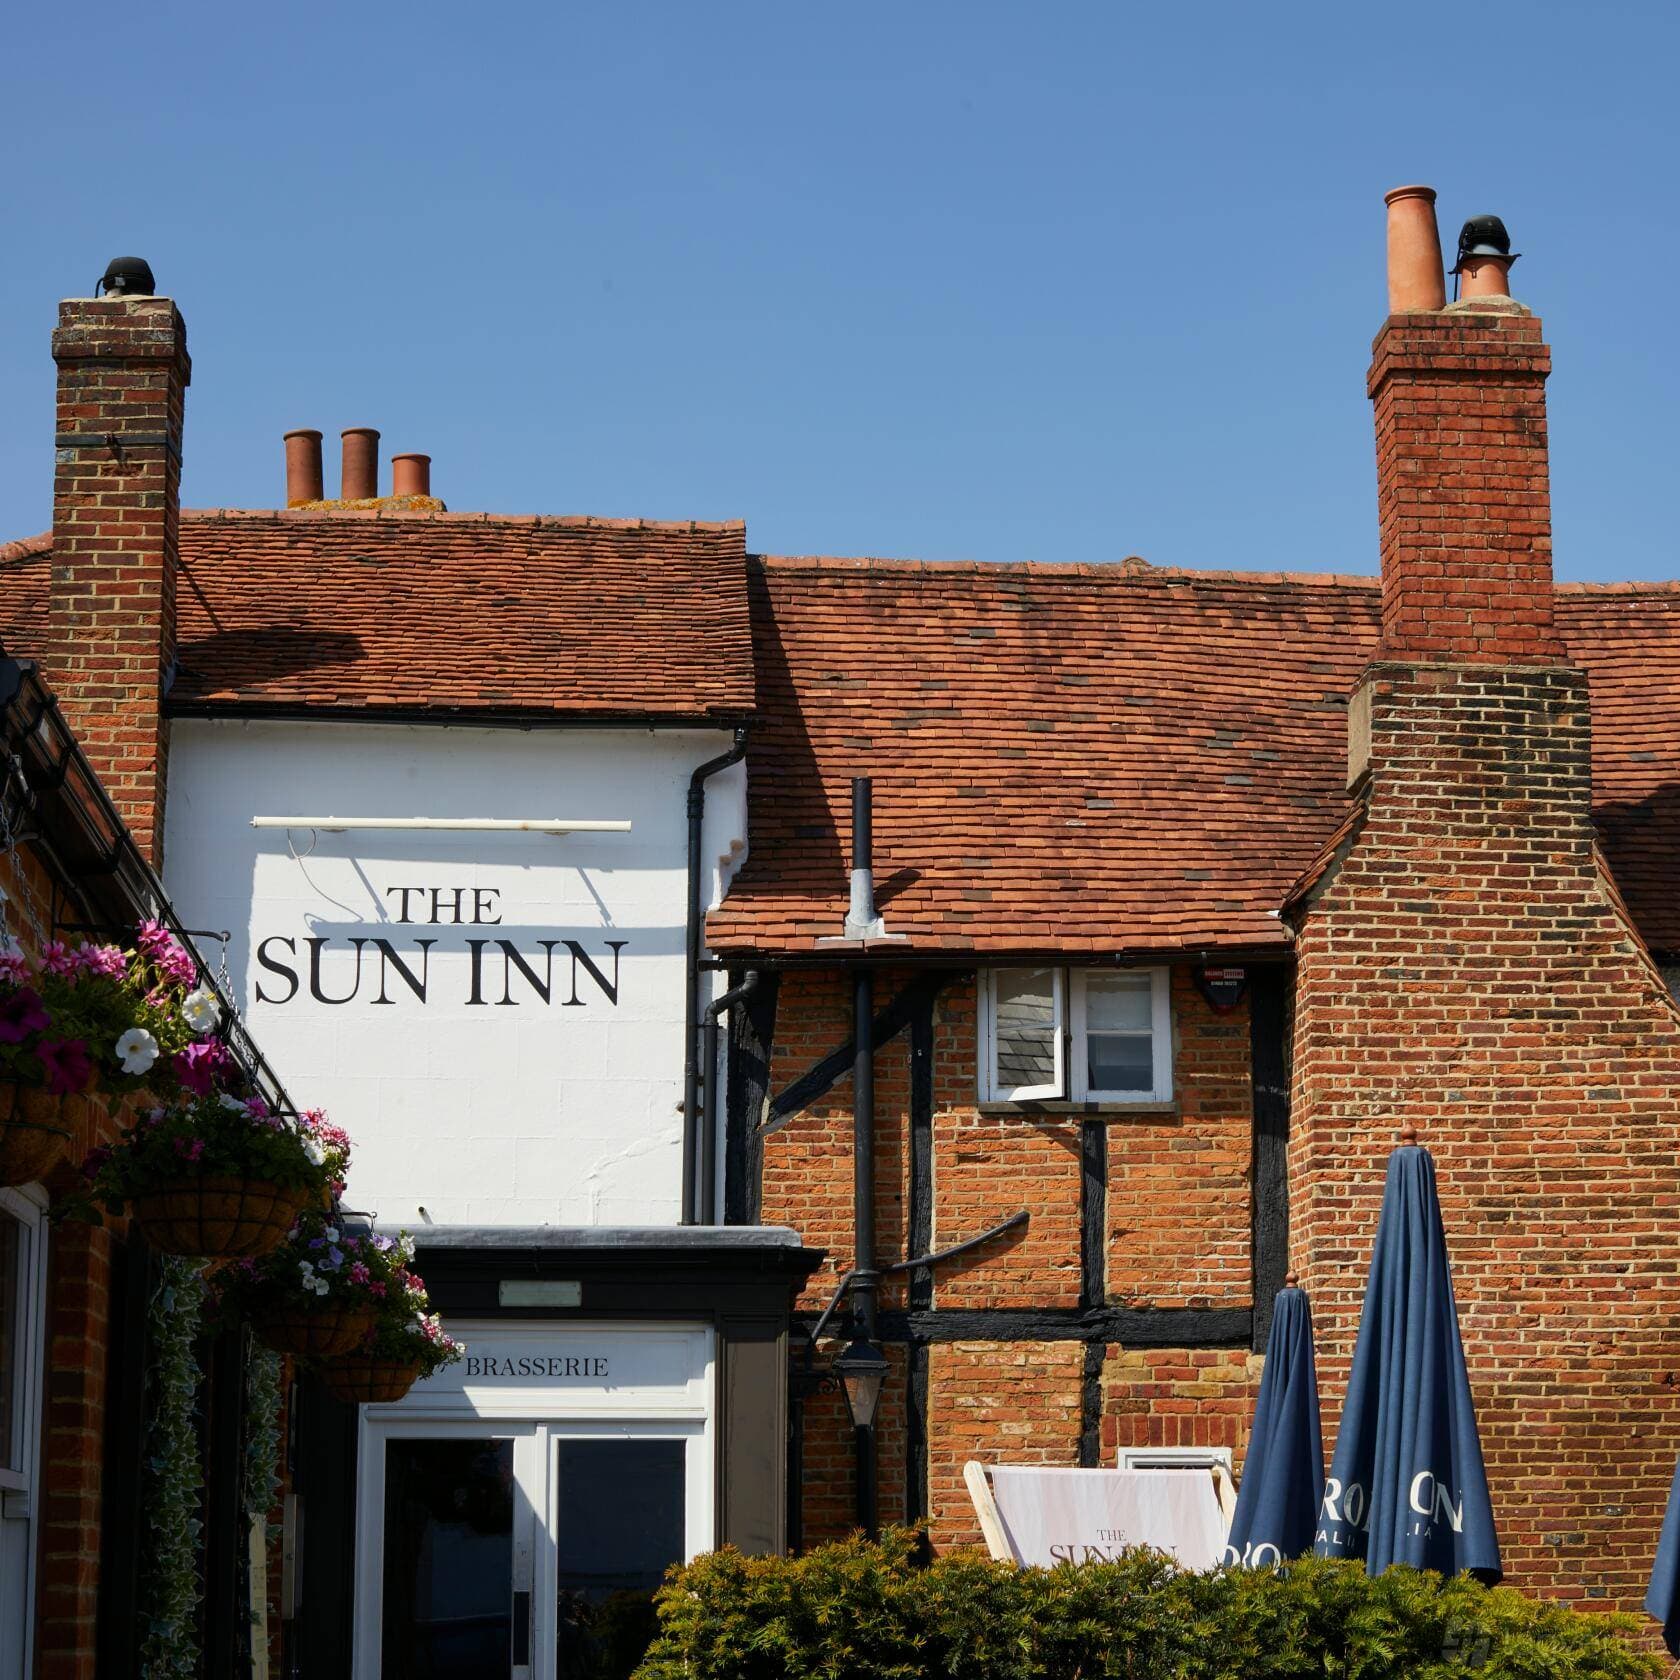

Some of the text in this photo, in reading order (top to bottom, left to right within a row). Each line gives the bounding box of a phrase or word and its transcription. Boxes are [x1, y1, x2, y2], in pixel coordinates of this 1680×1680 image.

[386, 887, 503, 925] THE
[255, 936, 630, 1006] SUN INN
[465, 1357, 609, 1377] BRASSERIE
[1096, 1529, 1127, 1542] THE
